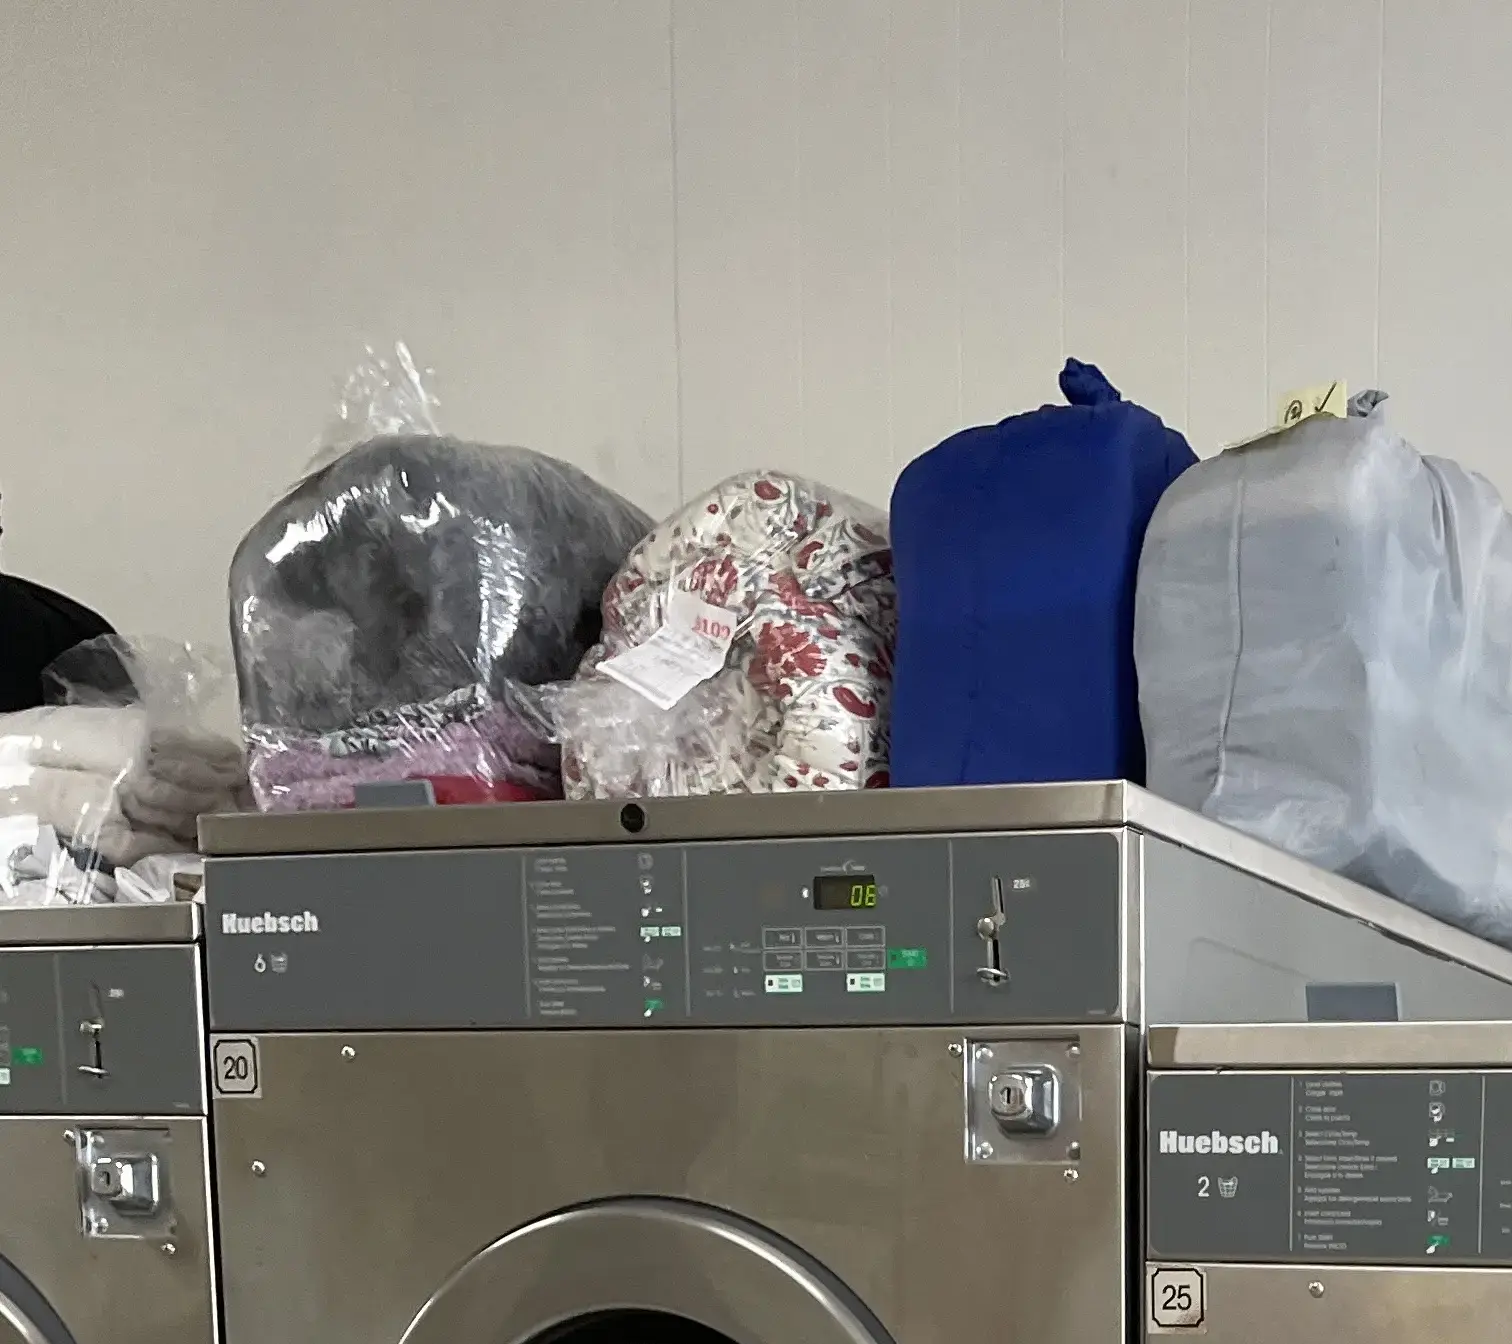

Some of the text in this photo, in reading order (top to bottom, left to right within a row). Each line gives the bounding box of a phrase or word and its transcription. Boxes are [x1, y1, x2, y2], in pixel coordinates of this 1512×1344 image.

[222, 911, 319, 934] Huebsch
[254, 953, 266, 973] 6
[223, 1055, 249, 1080] 20
[1159, 1130, 1279, 1154] Huebsch
[1197, 1175, 1210, 1198] 2
[1162, 1284, 1192, 1311] 25
